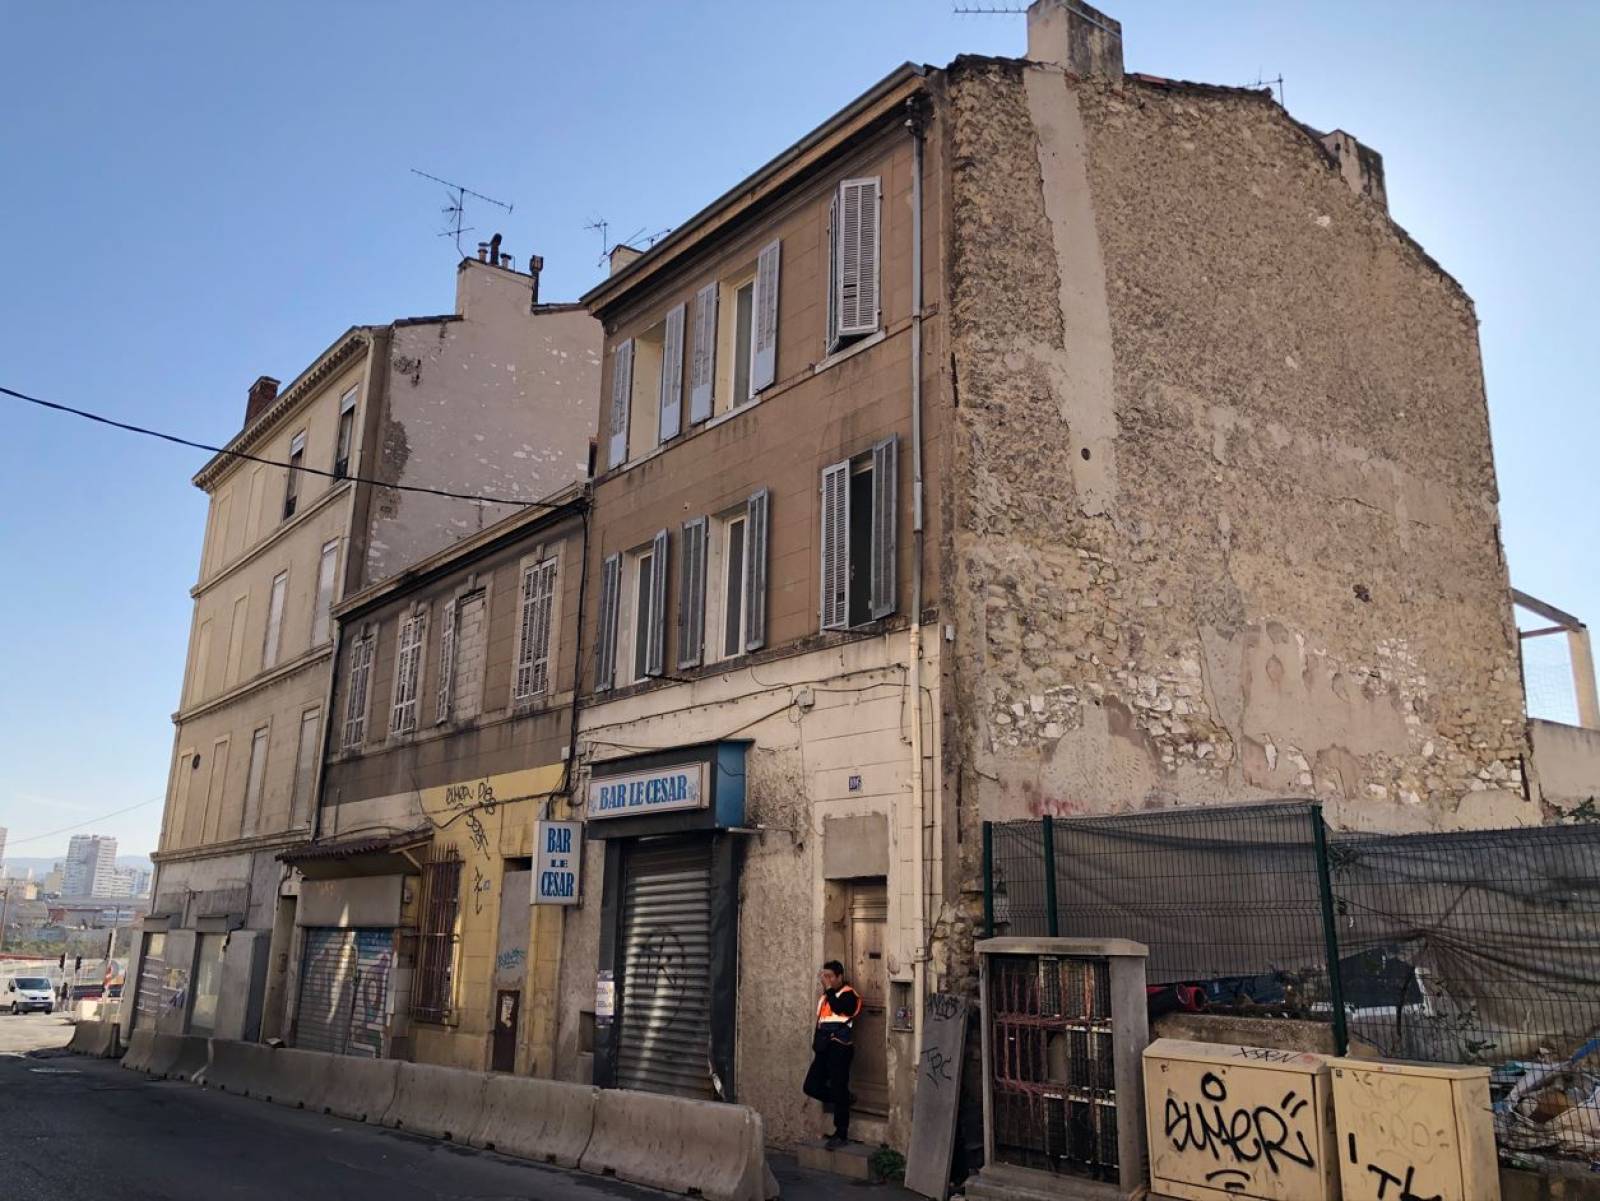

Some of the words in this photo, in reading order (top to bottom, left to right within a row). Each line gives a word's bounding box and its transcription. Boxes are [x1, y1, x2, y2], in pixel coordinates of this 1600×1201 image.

[600, 786, 627, 810] BAR
[629, 782, 644, 806] LE
[644, 774, 688, 803] CESAR
[547, 827, 571, 854] BAR
[551, 859, 568, 868] LE
[541, 871, 574, 897] CESAR
